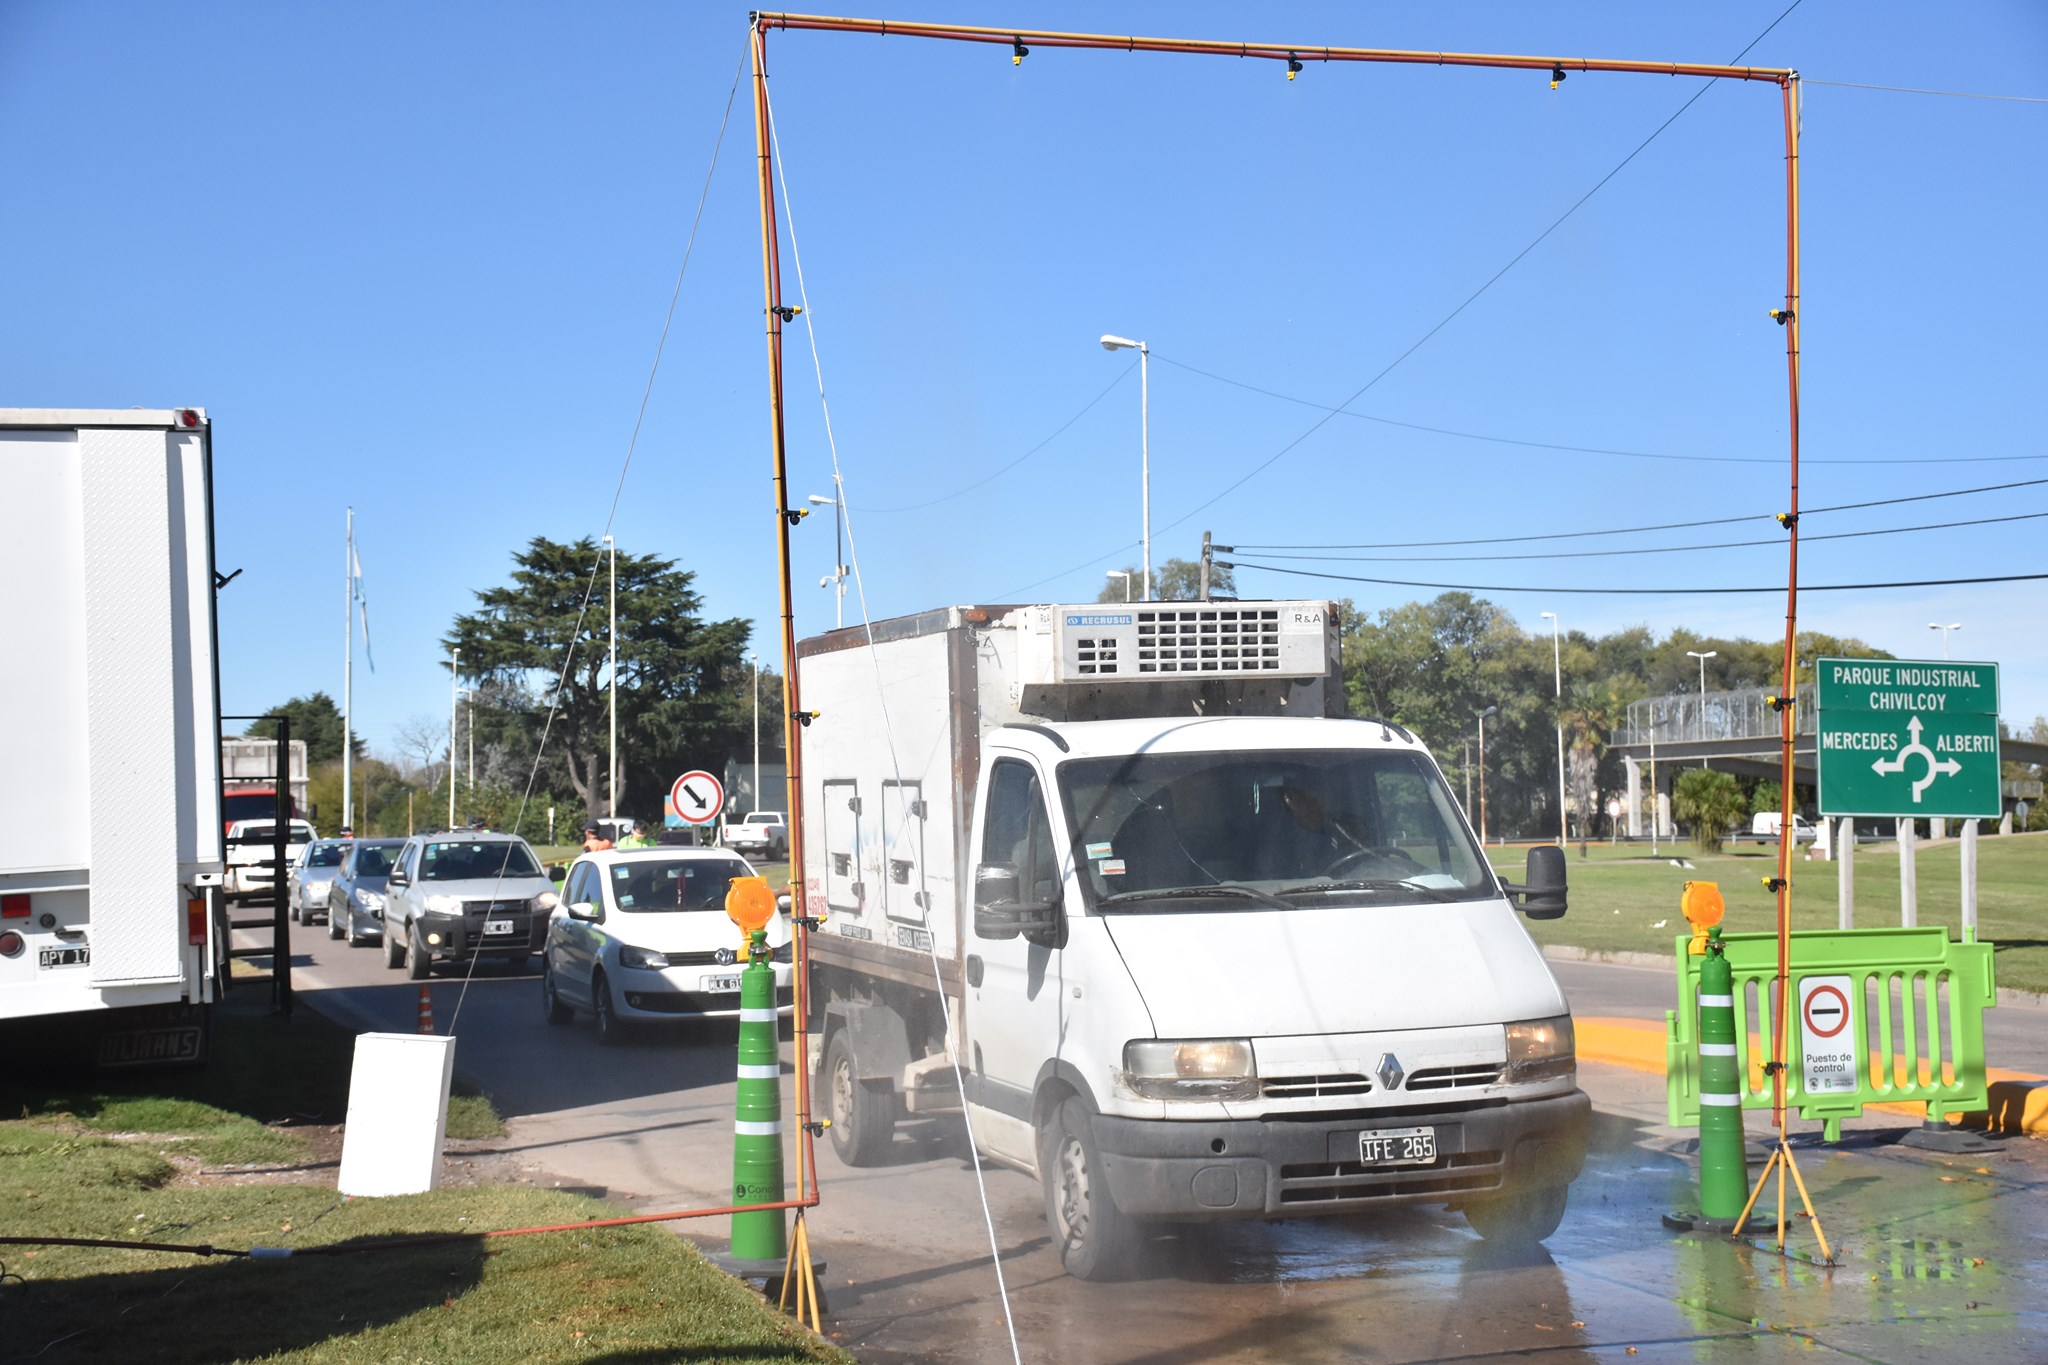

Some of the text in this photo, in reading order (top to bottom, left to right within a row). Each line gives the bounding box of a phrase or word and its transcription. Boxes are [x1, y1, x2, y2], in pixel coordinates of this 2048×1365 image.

[1081, 616, 1131, 625] RECRUSUL
[1834, 667, 1981, 688] PARQUE INDUSTRIAL
[1869, 692, 1946, 711] CHIVILCOY
[1822, 732, 1898, 751] MERCEDES
[1936, 735, 1995, 753] ALBERTI
[41, 948, 90, 966] APY 17
[729, 979, 742, 990] 61
[1806, 1053, 1852, 1063] Puesto de
[1813, 1063, 1846, 1073] control
[1363, 1137, 1434, 1160] IFE 265
